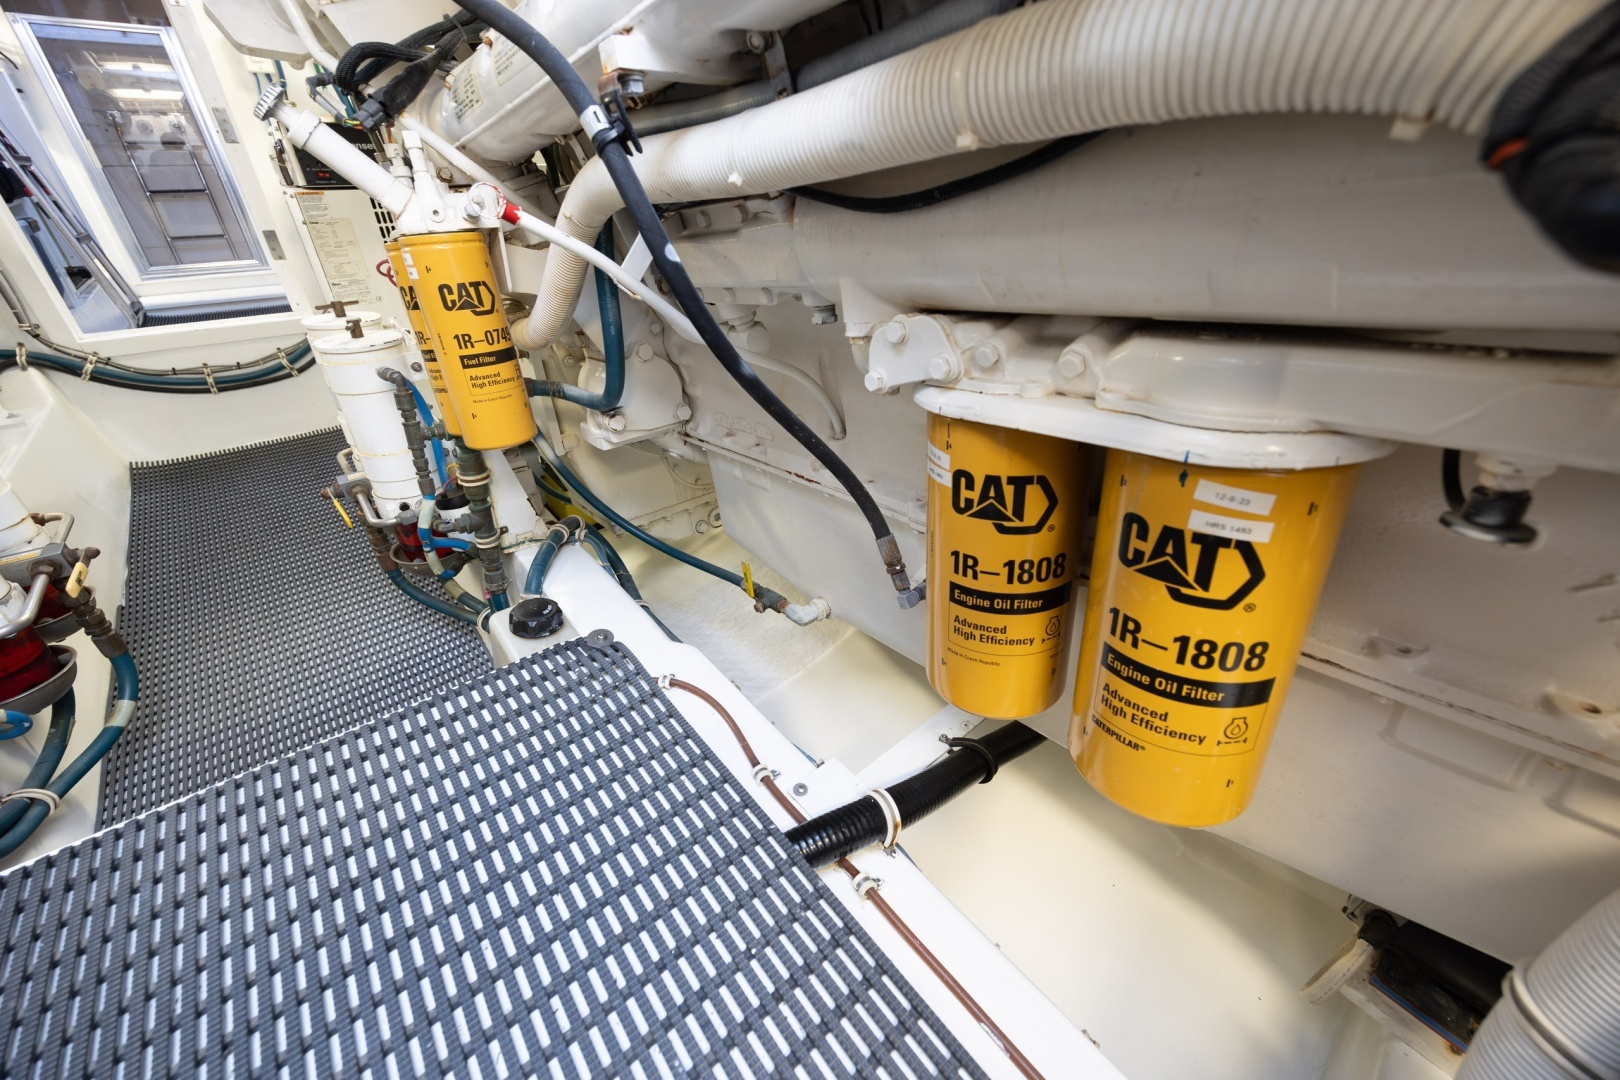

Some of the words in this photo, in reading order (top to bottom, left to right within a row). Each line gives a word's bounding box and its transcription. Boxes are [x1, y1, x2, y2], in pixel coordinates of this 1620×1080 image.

[438, 281, 485, 312] CAT
[463, 358, 479, 366] Fuel
[479, 355, 496, 364] Filter
[469, 371, 501, 382] Advanced
[471, 380, 487, 389] High
[488, 376, 515, 387] Efficiency
[951, 469, 1036, 523] CAT
[950, 549, 1068, 585] 1R-1808
[1118, 512, 1233, 593] CAT
[954, 589, 991, 608] Engine
[993, 598, 1011, 610] Oil
[1014, 598, 1044, 610] Filter
[953, 614, 1007, 635] Advanced
[953, 626, 976, 641] High
[979, 633, 1036, 646] Efficiency
[1108, 606, 1270, 673] 1R-1808
[979, 658, 1001, 667] Republic
[1107, 653, 1151, 683] Engine
[1154, 677, 1177, 694] Oil
[1181, 685, 1226, 702] Filter
[1102, 682, 1169, 723] Advanced
[1101, 695, 1127, 719] High
[1130, 713, 1207, 746] Efficiency
